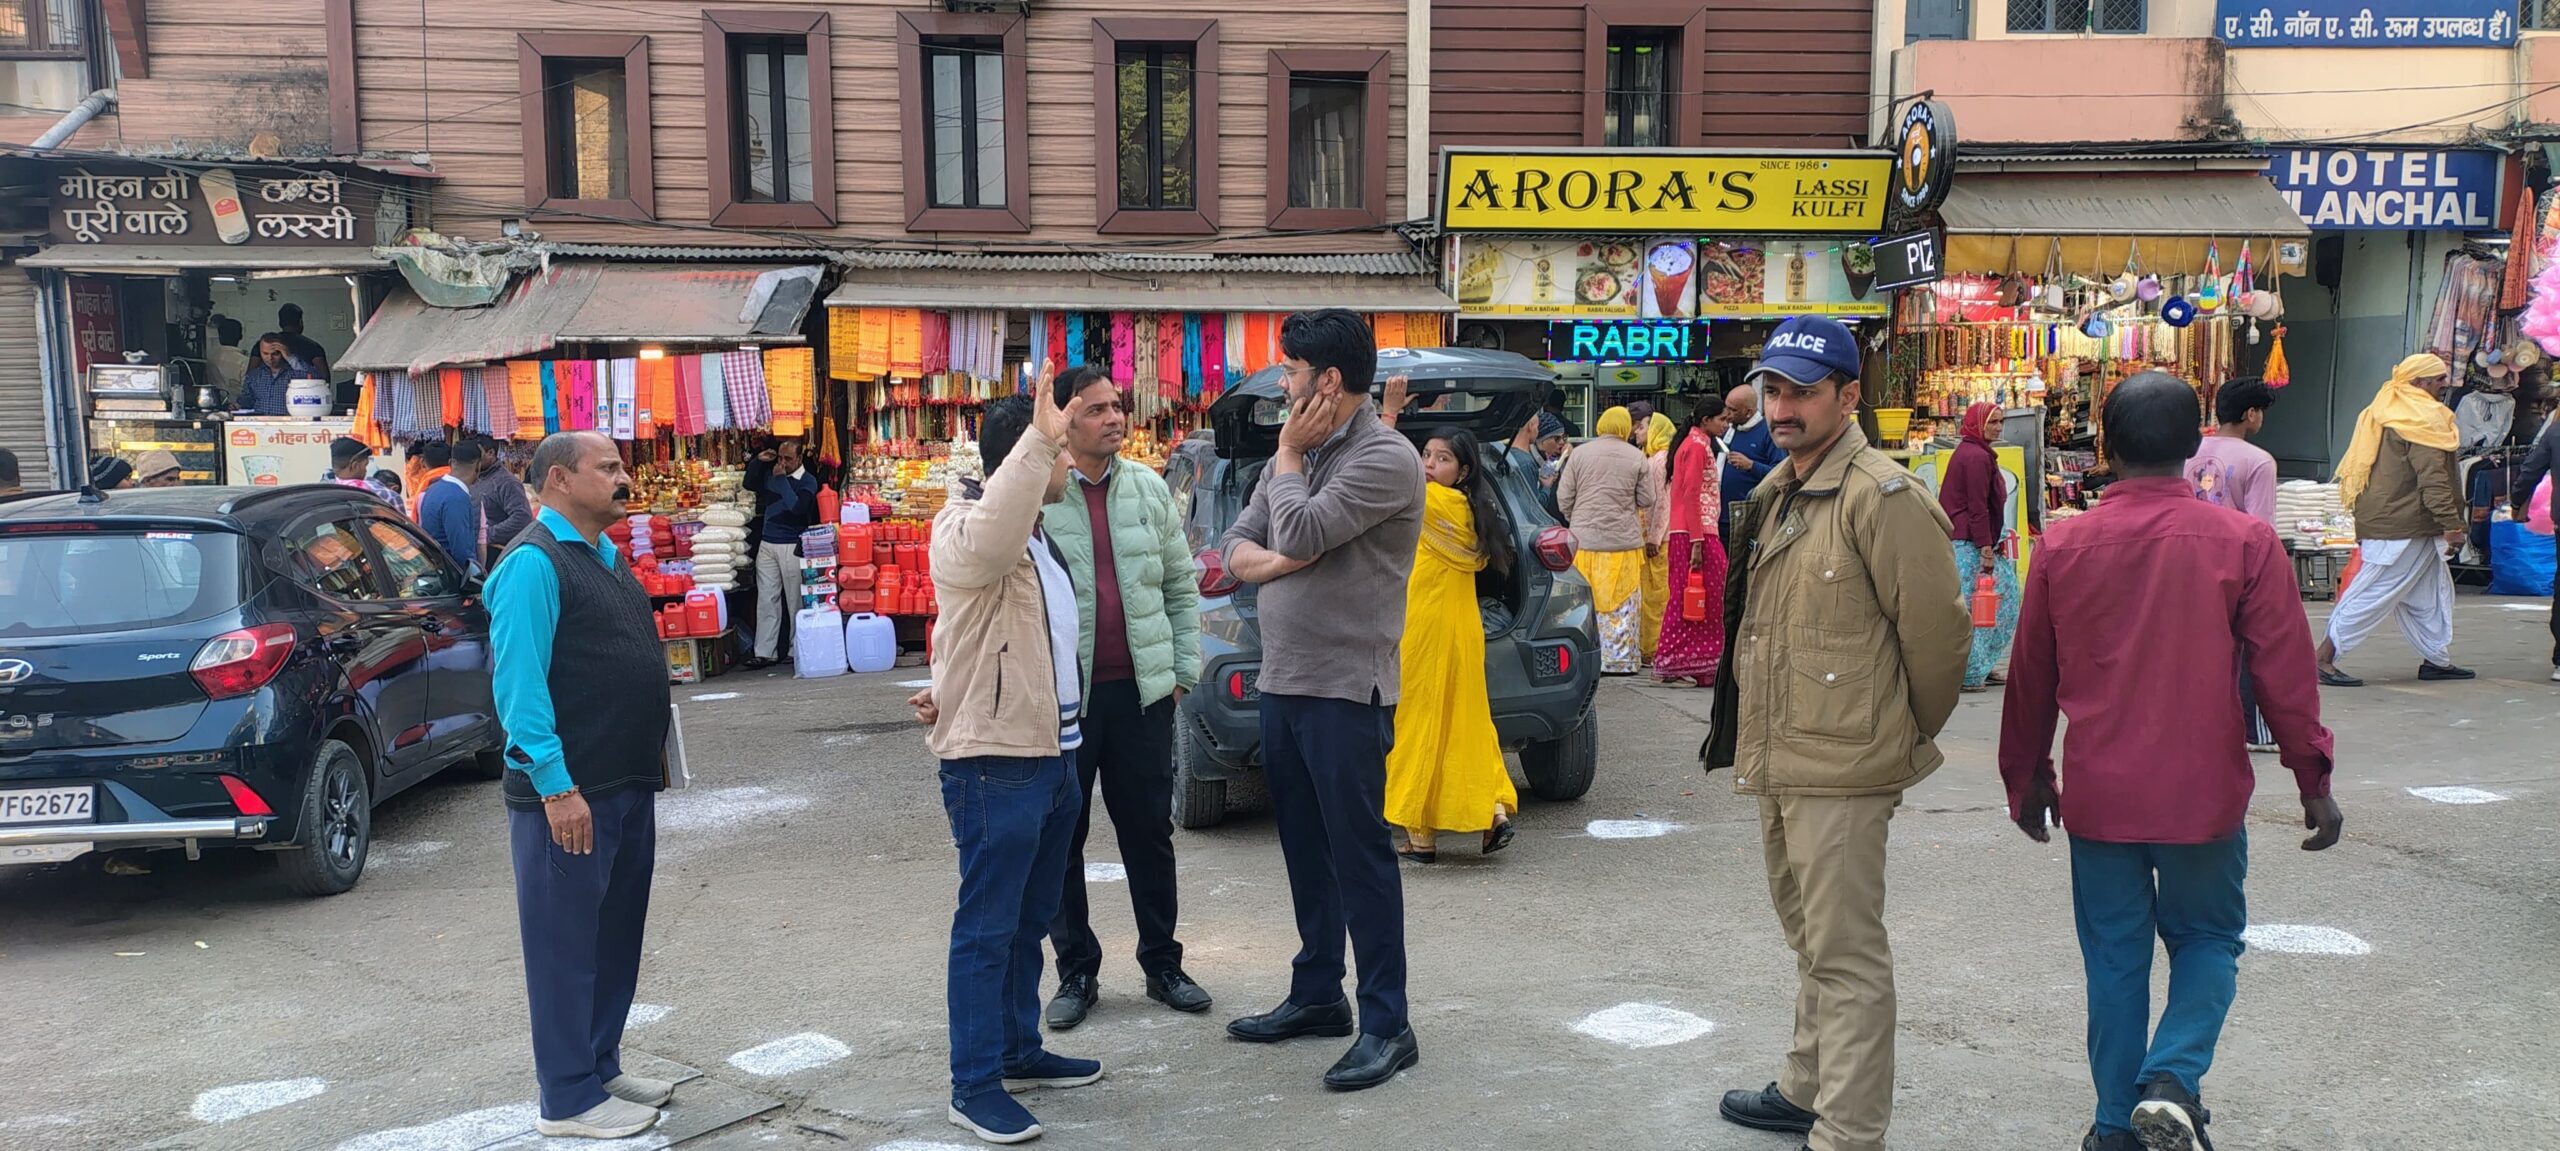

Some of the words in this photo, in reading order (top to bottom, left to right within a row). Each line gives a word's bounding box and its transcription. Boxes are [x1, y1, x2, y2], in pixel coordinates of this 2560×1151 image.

[2250, 8, 2278, 38] सी.
[2285, 10, 2321, 38] नॉन
[2350, 8, 2378, 38] सी.
[2423, 16, 2483, 38] उपलब्ध
[1902, 104, 1934, 141] ARORA'S
[1759, 160, 1790, 170] SINCE
[1794, 160, 1820, 170] 1986
[2288, 151, 2459, 186] HOTEL
[58, 167, 146, 201] मोहन
[148, 168, 190, 200] जी
[1456, 168, 1758, 215] ARORA'S
[1793, 179, 1869, 197] LASSI
[1790, 201, 1866, 217] KULFI
[2278, 190, 2489, 226] LANCHAL
[63, 201, 124, 244] पूरी
[124, 202, 189, 235] वाले
[255, 205, 357, 240] लस्सी
[1462, 305, 1478, 313] STICK
[1604, 306, 1626, 314] FALUDA
[1777, 304, 1791, 312] MILK
[1792, 304, 1813, 312] BADAM
[1838, 304, 1861, 312] KULHAD
[1861, 304, 1878, 312] RABRI
[1572, 325, 1690, 358] RABRI
[1768, 332, 1827, 354] POLICE
[146, 532, 193, 540] POLICE
[137, 652, 181, 661] Sportz
[0, 710, 54, 727] OS
